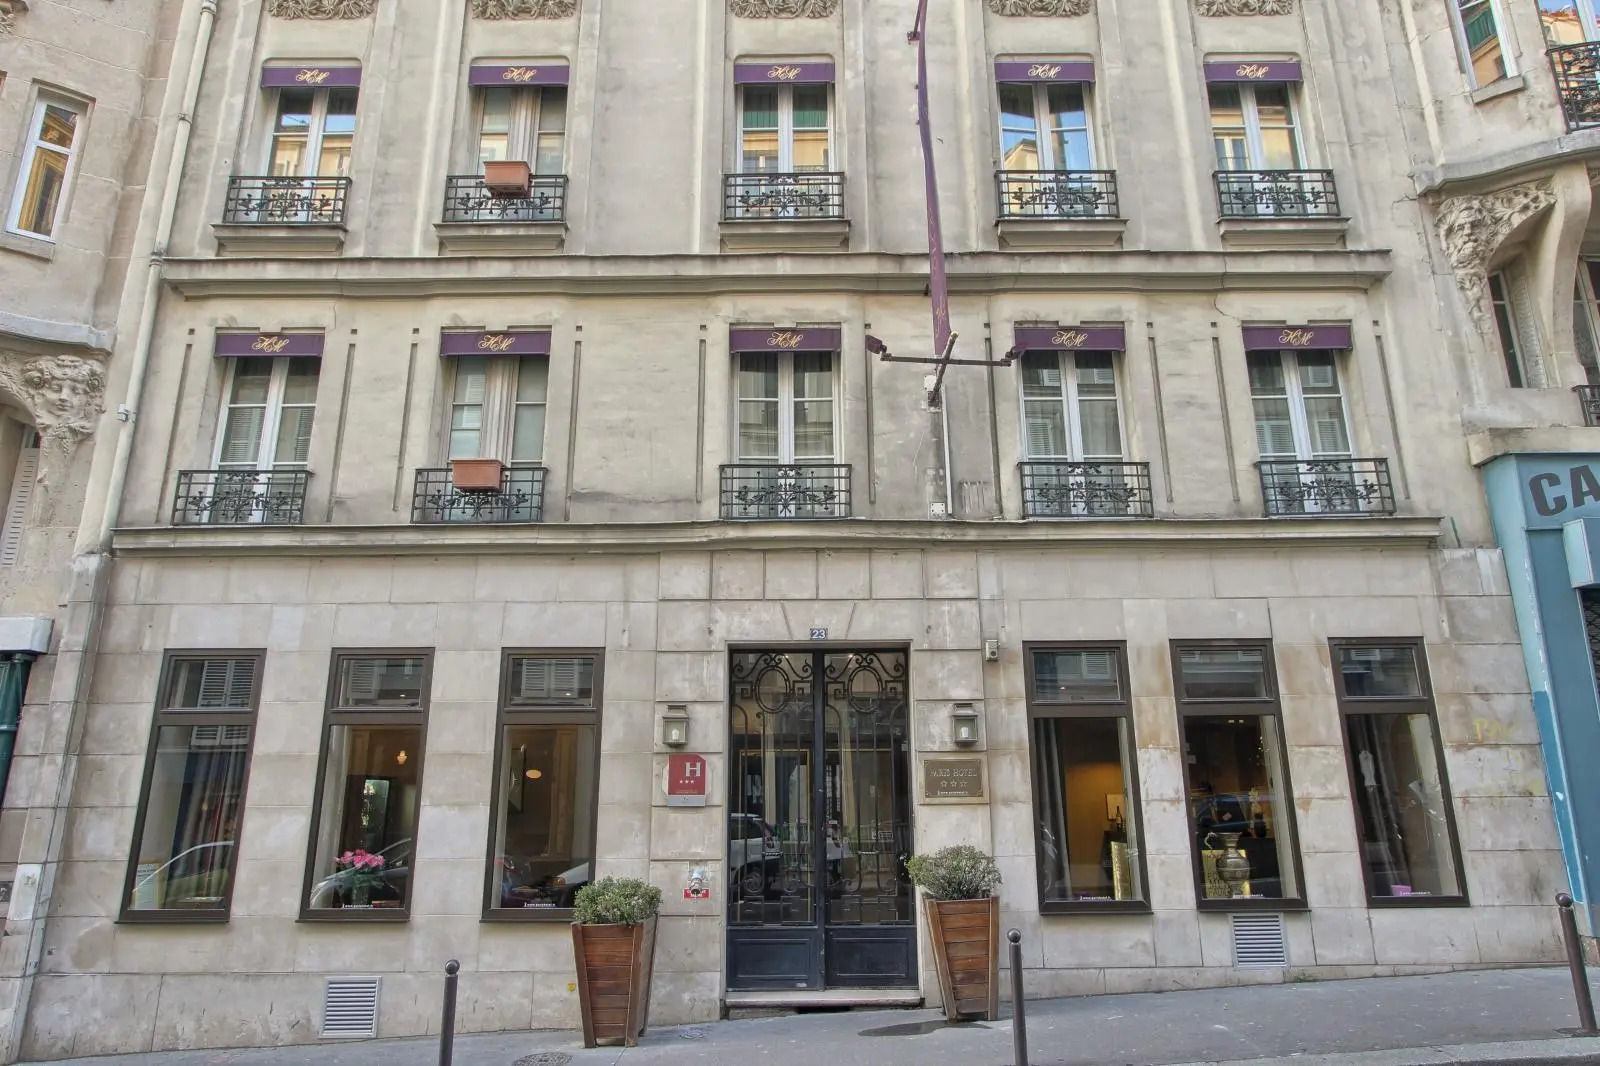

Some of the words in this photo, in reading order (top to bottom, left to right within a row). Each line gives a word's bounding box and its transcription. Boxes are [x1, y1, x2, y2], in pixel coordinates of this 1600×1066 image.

[812, 629, 826, 639] 23
[685, 762, 701, 777] H
[953, 768, 977, 777] HOTEL
